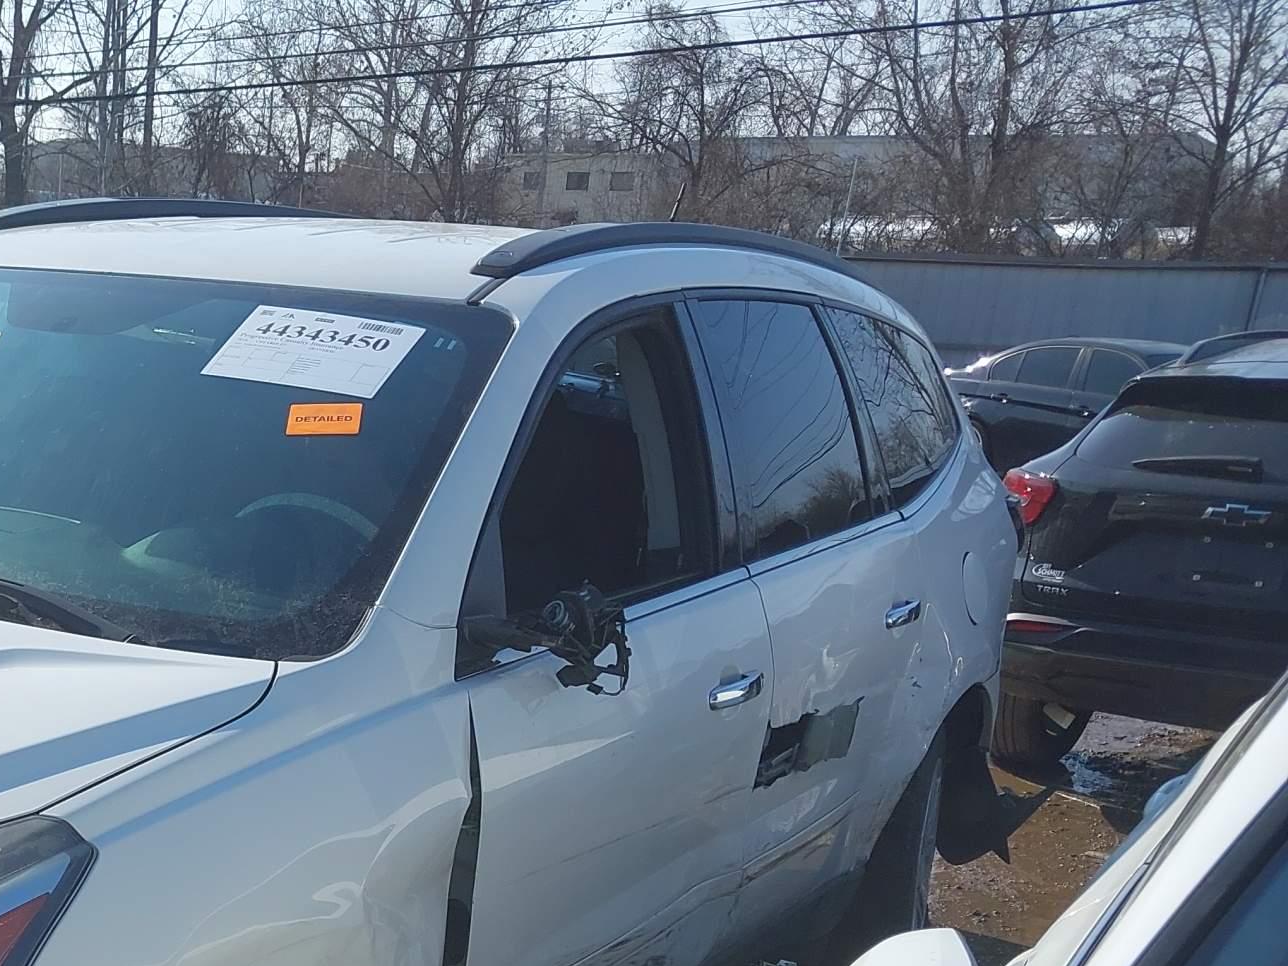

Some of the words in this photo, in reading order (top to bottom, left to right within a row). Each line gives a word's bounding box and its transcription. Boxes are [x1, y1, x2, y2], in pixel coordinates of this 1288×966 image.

[256, 321, 391, 352] 44343450
[295, 415, 353, 424] DETAILED
[1037, 585, 1068, 595] TRAX
